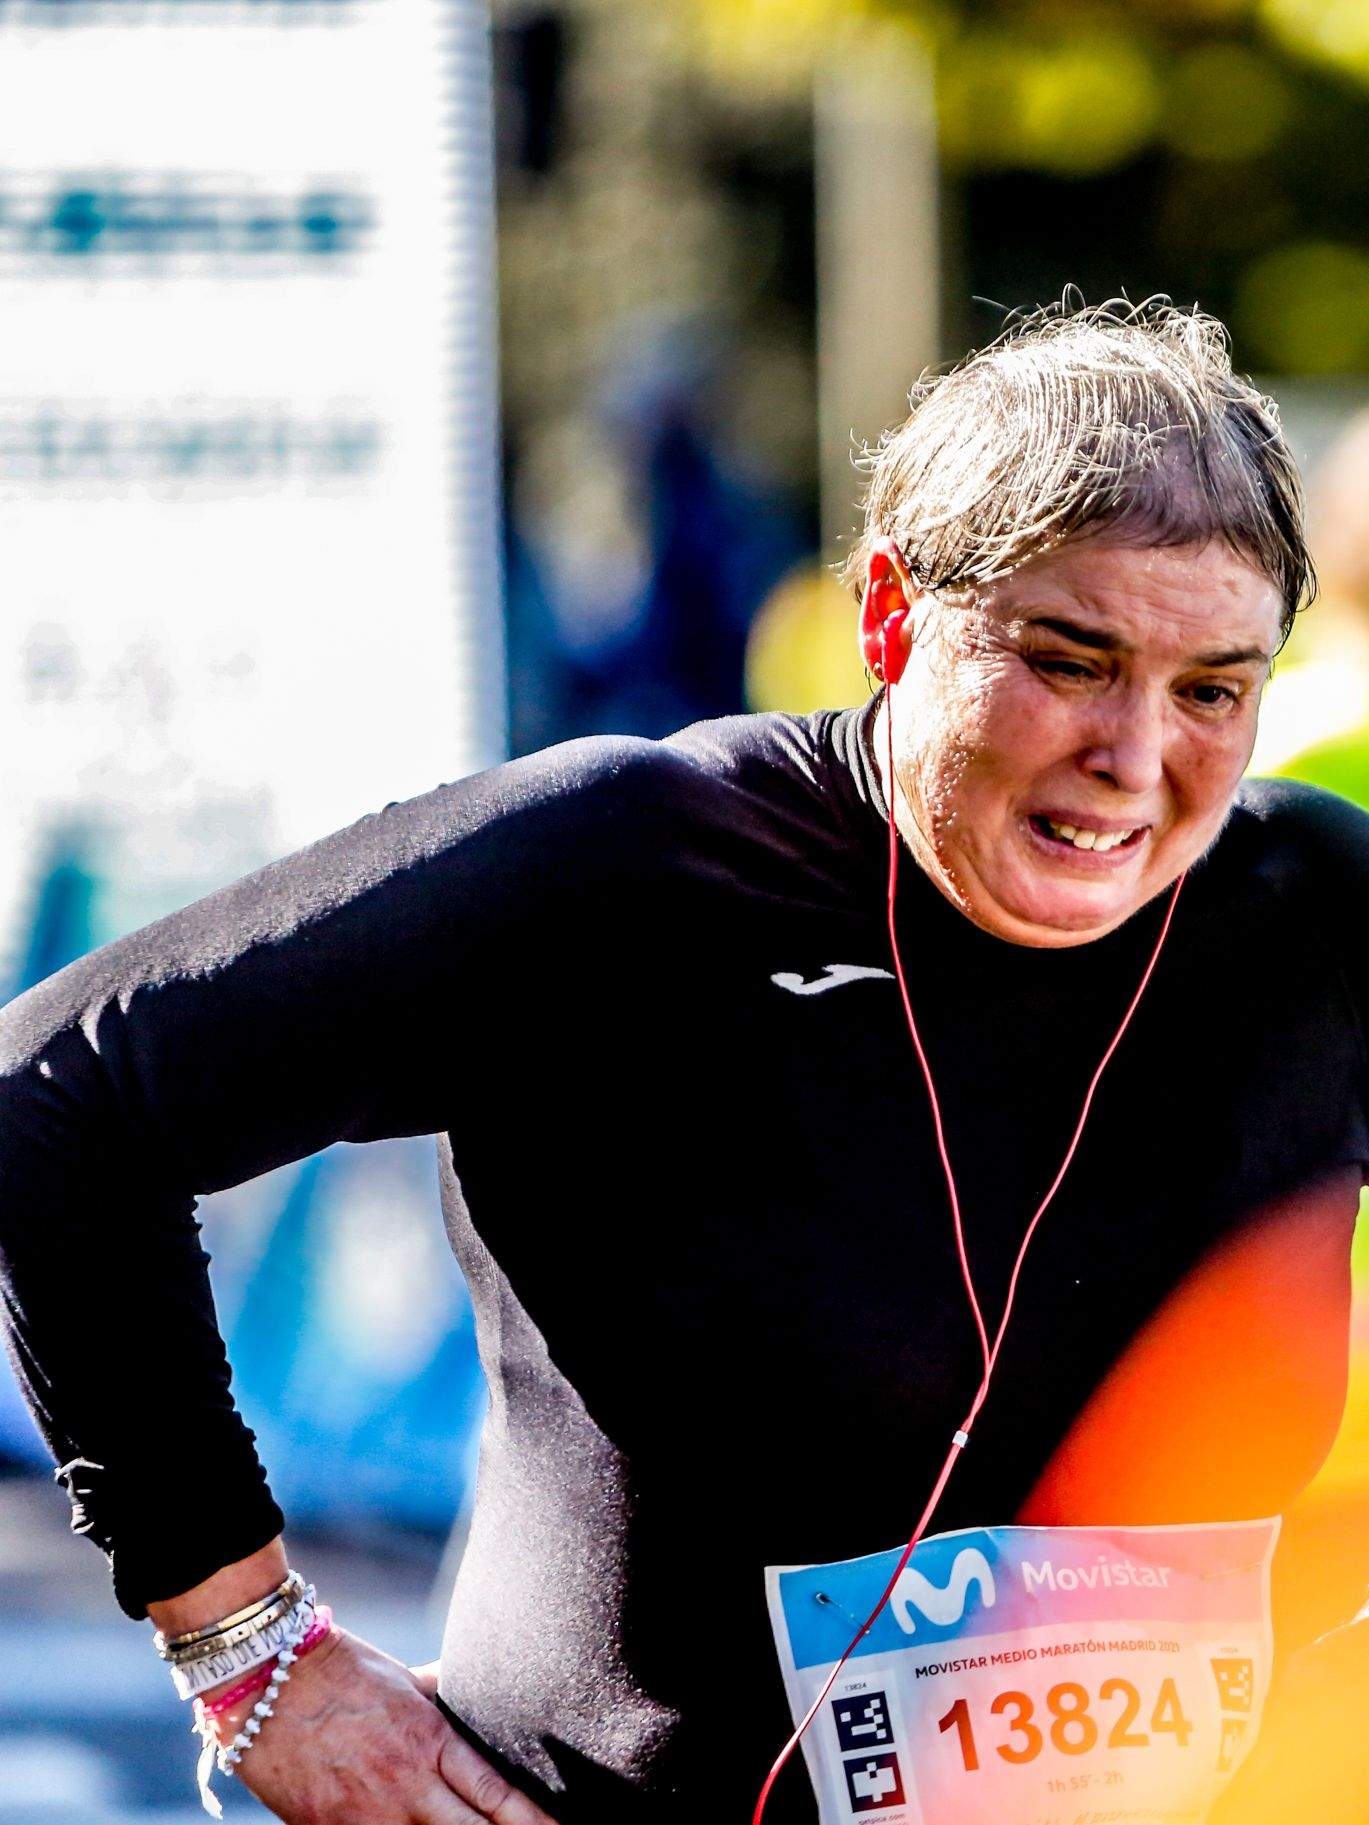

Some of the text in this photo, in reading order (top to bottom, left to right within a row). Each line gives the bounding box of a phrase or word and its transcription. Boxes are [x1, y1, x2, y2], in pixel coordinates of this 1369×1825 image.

[1021, 1556, 1171, 1593] Movistar
[915, 1656, 988, 1679] MOVISTAR
[990, 1648, 1037, 1666] MEDIO
[1040, 1639, 1106, 1659] MARATÓN
[1109, 1641, 1156, 1653] MADRID
[938, 1677, 1193, 1771] 13824
